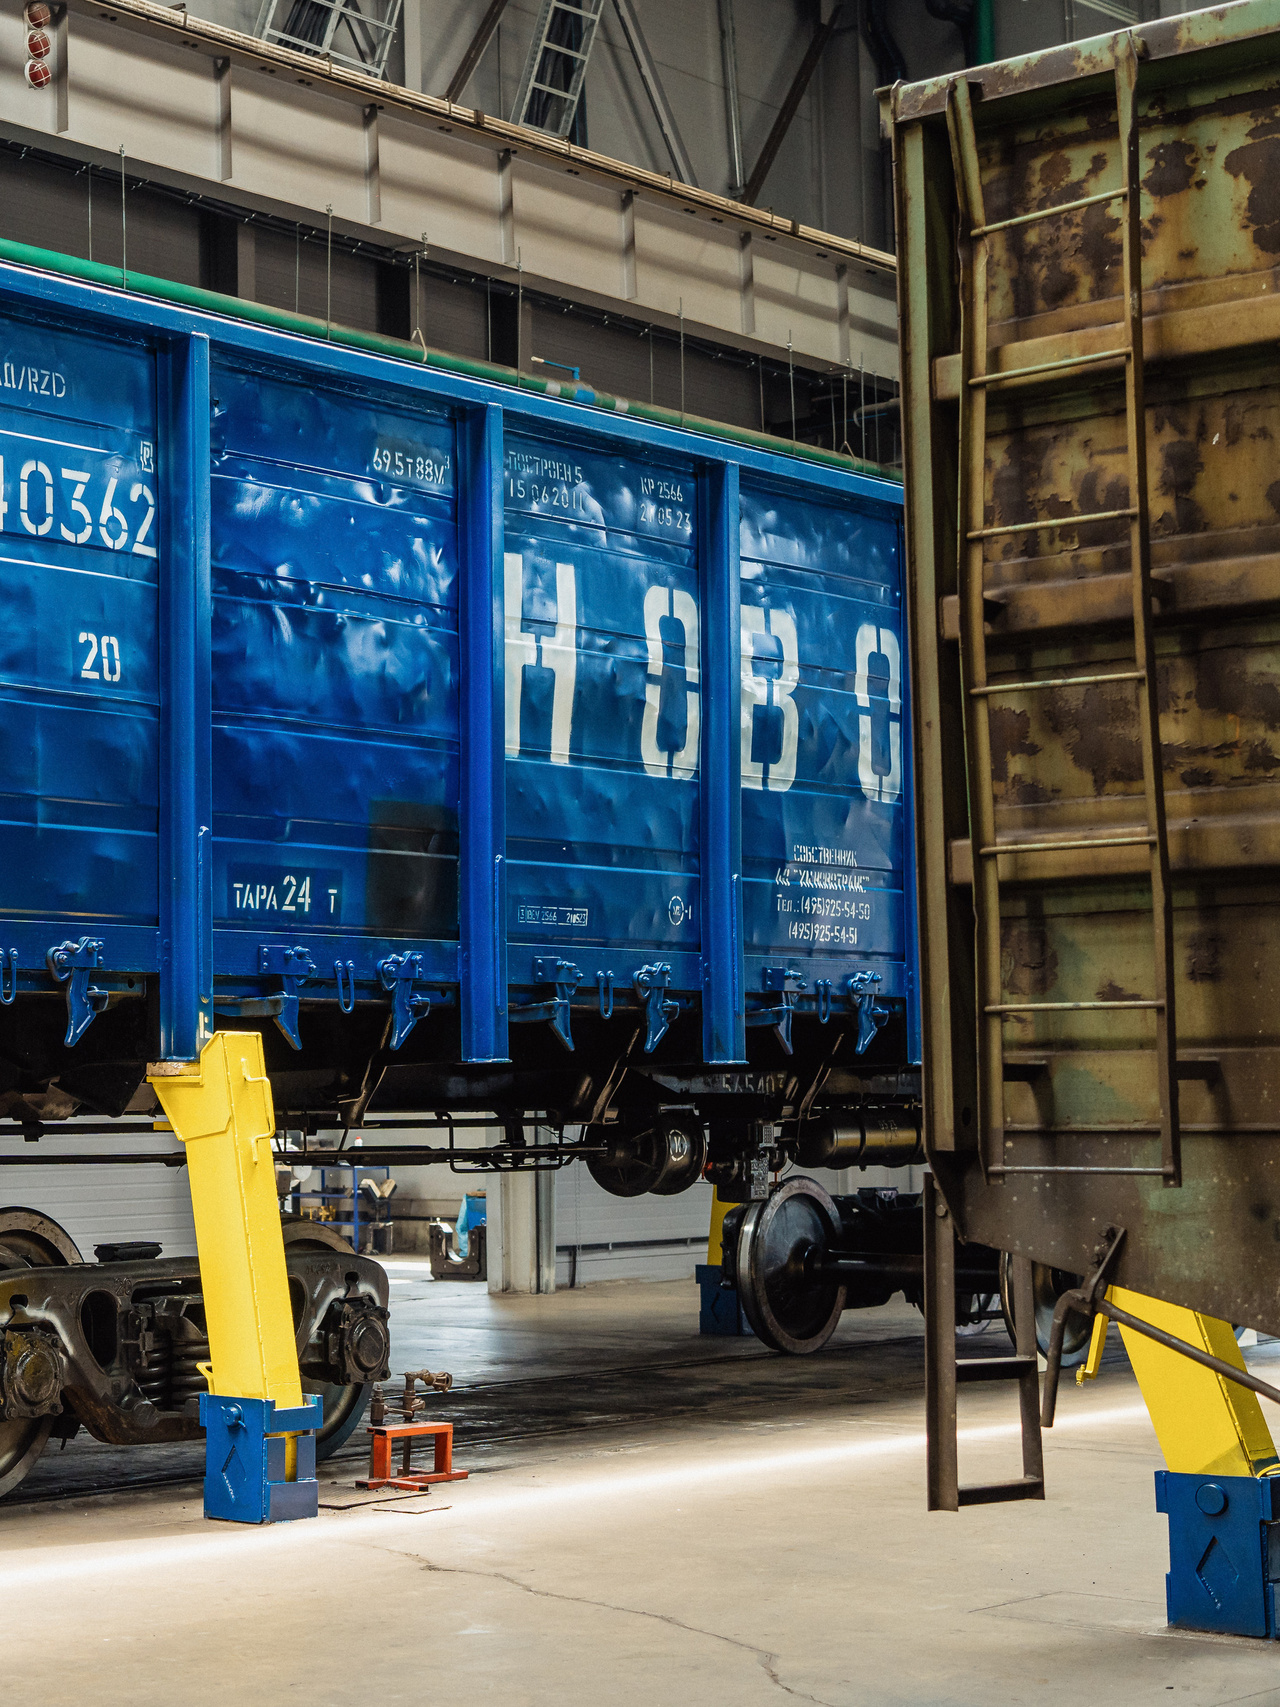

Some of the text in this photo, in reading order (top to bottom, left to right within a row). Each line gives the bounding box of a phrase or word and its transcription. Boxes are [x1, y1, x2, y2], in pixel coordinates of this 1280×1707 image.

[657, 481, 683, 502] 2566
[78, 632, 120, 682] 20
[793, 844, 858, 867] СОБСТВЕННИК
[233, 883, 278, 910] ТАРА
[282, 874, 311, 912] 24
